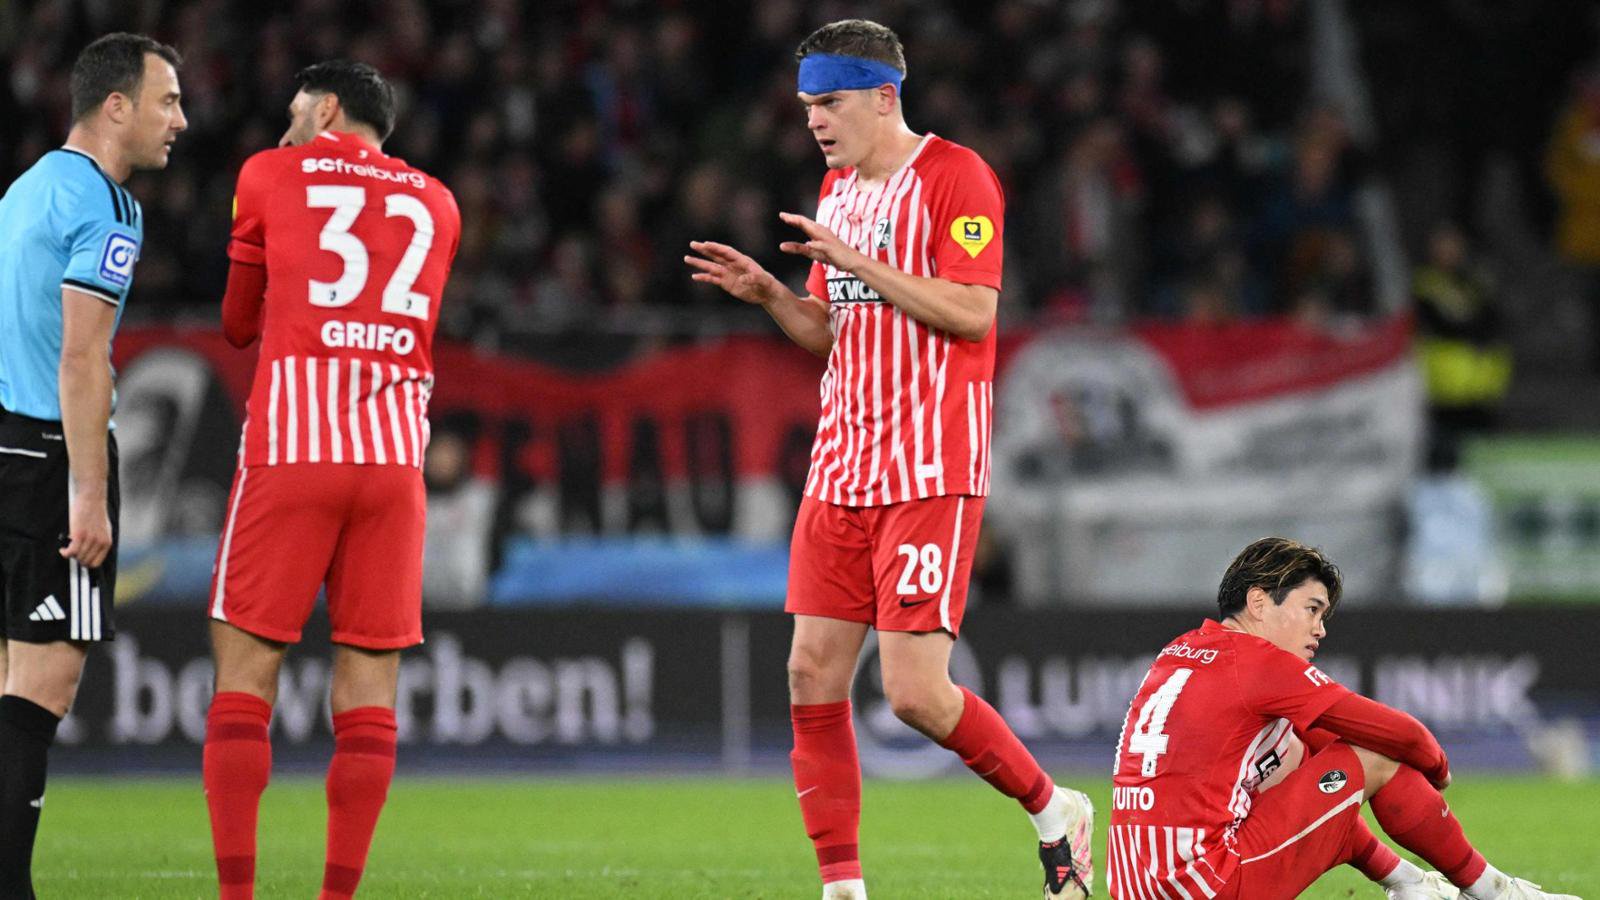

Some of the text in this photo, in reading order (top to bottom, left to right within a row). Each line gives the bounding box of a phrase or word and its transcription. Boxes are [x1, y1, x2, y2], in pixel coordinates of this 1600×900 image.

[306, 184, 434, 321] 32
[321, 320, 415, 355] GRIFO
[896, 543, 943, 595] 28
